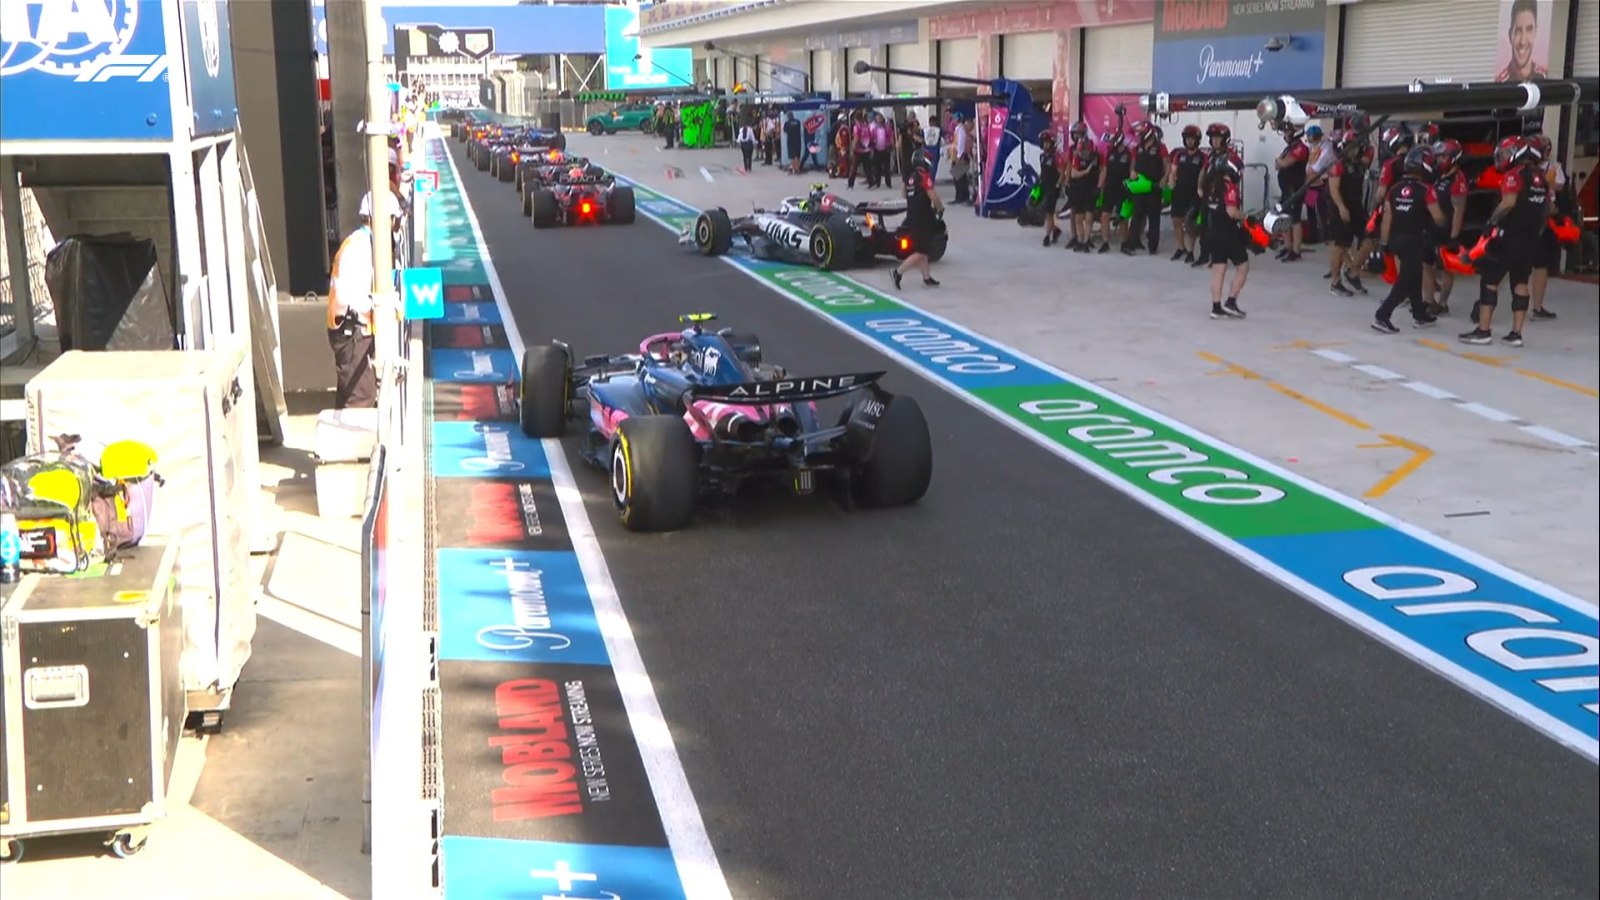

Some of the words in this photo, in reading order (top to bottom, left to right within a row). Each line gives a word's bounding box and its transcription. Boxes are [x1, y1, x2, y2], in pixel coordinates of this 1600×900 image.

[1162, 0, 1228, 32] MOBLAND
[1233, 4, 1244, 15] NEW
[1246, 2, 1264, 14] SERIES
[1265, 1, 1279, 12] NOW
[1197, 44, 1264, 84] Paramount+
[994, 112, 1001, 123] 6
[411, 283, 440, 306] W
[865, 318, 1016, 374] aramco
[729, 376, 856, 397] ALPINE
[864, 399, 885, 418] MSC
[1018, 398, 1287, 505] aramco
[1342, 565, 1599, 716] ara
[488, 677, 584, 823] MOBLAND
[574, 724, 599, 748] NOW
[579, 746, 606, 778] SERIES
